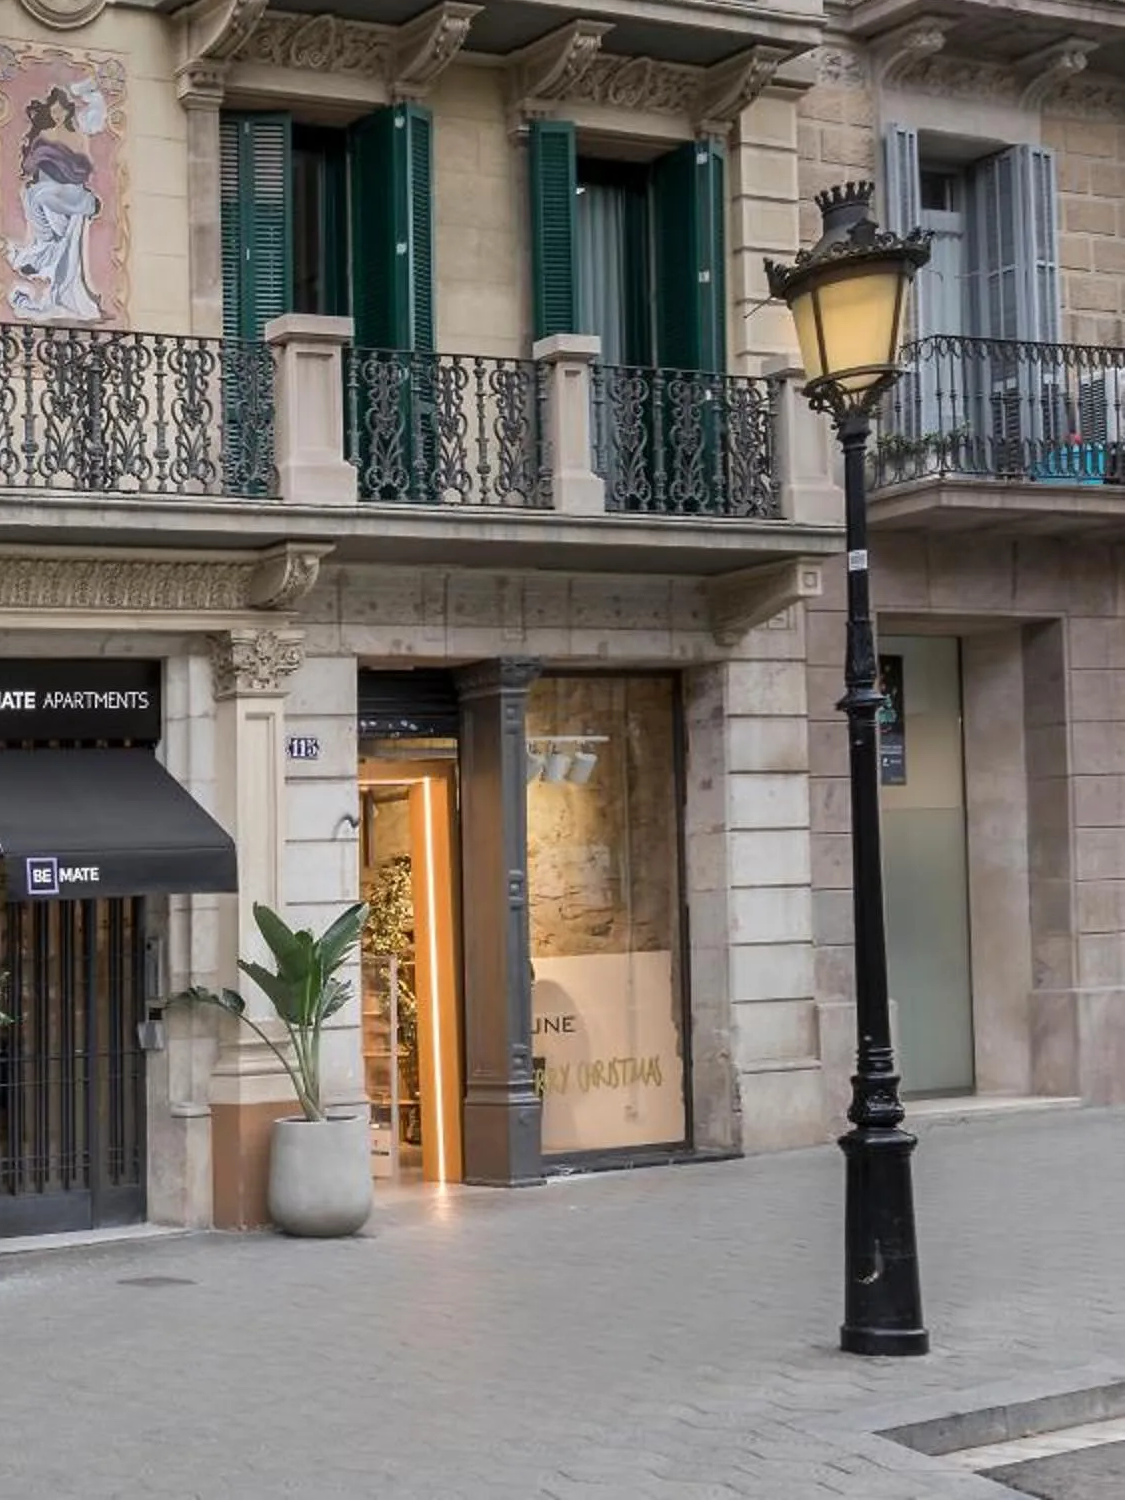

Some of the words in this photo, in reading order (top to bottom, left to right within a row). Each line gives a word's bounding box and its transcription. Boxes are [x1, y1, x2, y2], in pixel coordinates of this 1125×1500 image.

[42, 690, 150, 710] APARTMENTS
[291, 739, 317, 757] 115
[32, 868, 52, 883] BE
[59, 867, 100, 883] MATE
